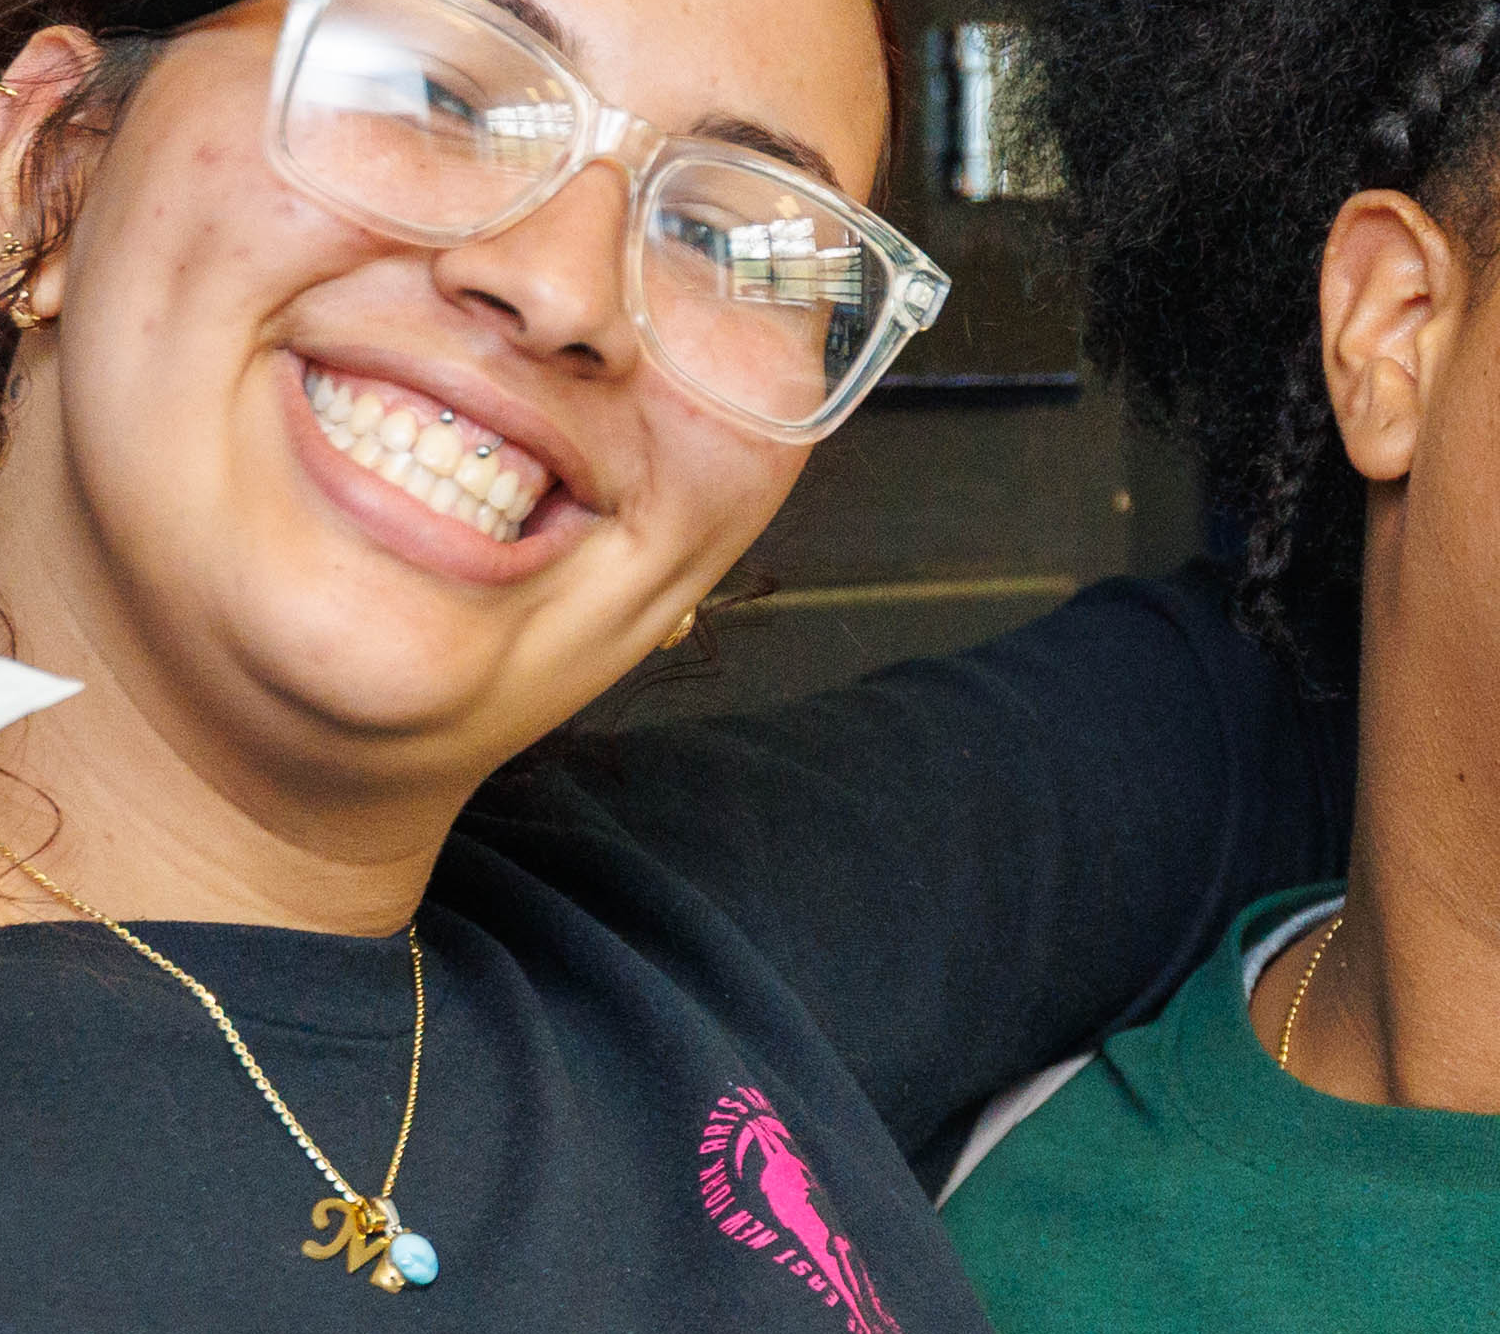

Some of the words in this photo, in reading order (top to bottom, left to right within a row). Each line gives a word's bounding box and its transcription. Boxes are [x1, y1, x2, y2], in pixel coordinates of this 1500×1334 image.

[699, 1096, 749, 1154] ARTS
[699, 1158, 736, 1219] YORK
[718, 1210, 779, 1249] NEW
[771, 1249, 840, 1308] EAST
